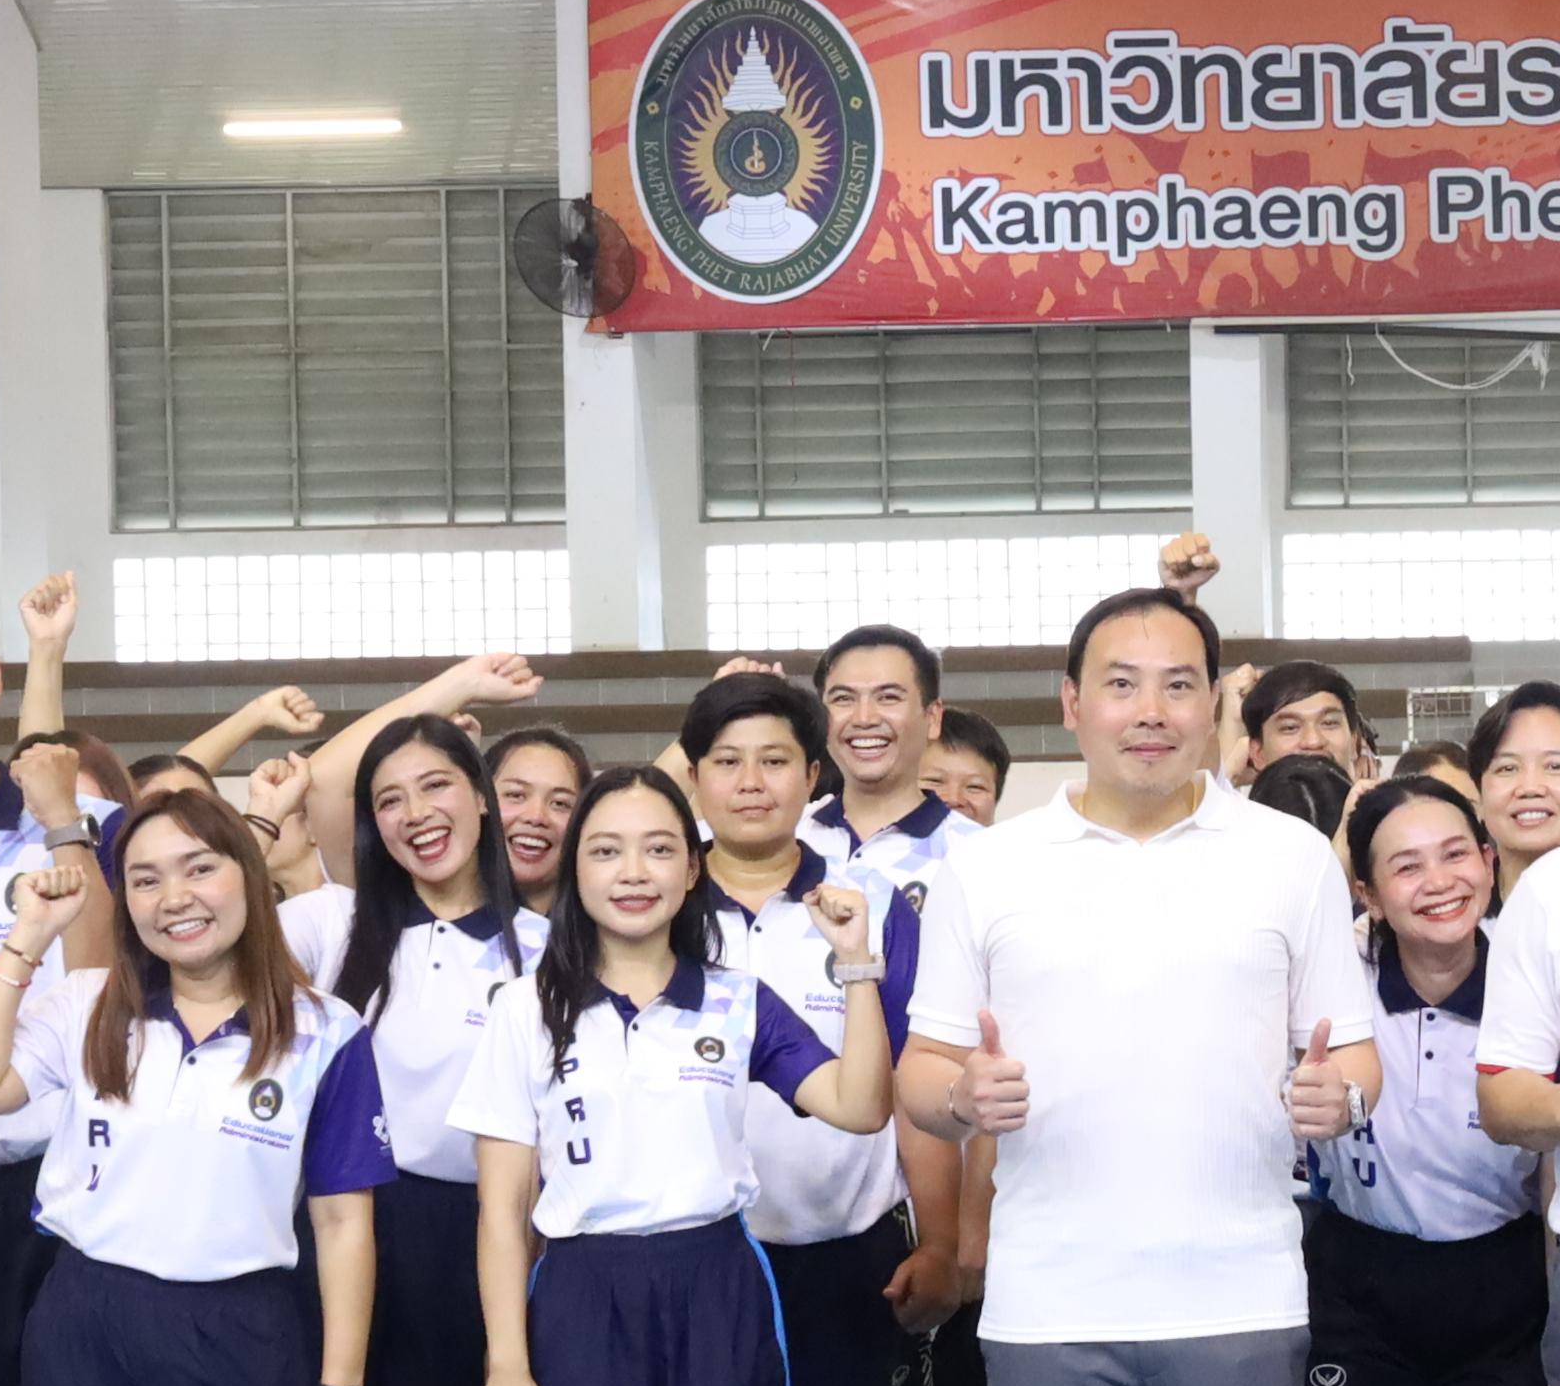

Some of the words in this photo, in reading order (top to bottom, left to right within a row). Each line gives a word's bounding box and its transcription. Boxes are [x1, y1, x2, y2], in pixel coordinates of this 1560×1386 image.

[642, 140, 695, 253] KAMPHAENG
[691, 251, 736, 284] PHET
[740, 247, 829, 293] RAJABHAT
[828, 140, 868, 247] UNIVERSITY
[939, 180, 1397, 257] Kamphaeng
[553, 1033, 592, 1166] PRU
